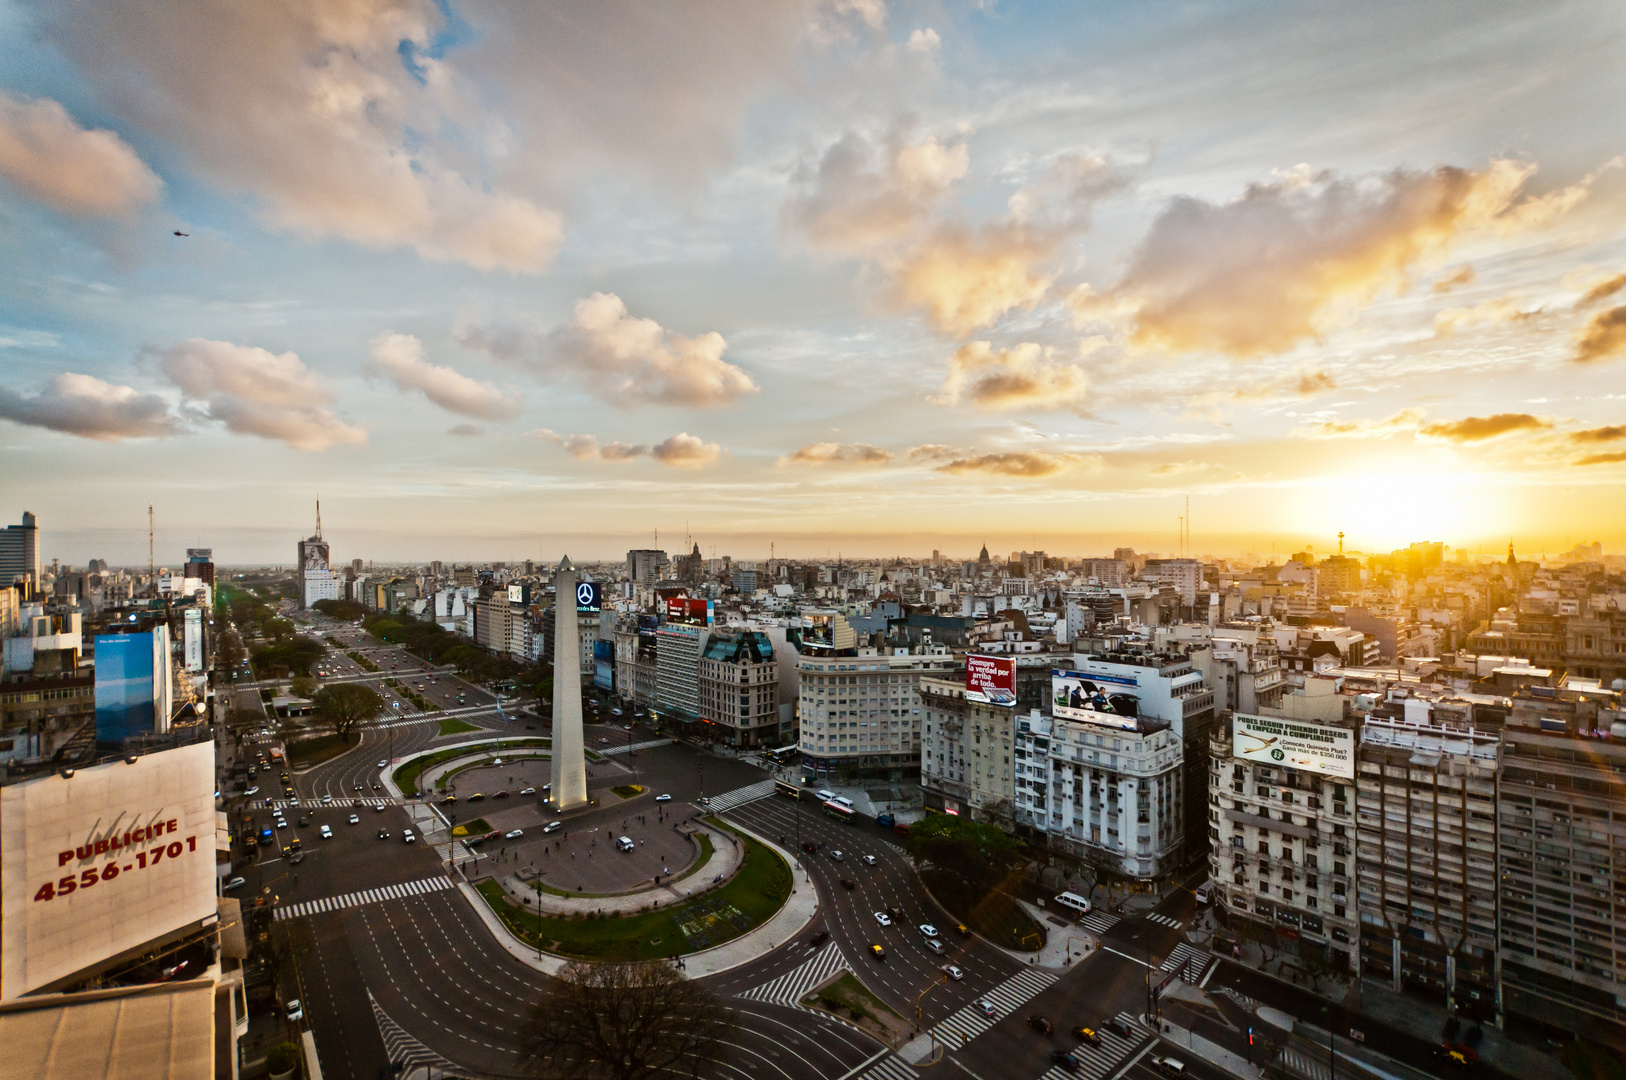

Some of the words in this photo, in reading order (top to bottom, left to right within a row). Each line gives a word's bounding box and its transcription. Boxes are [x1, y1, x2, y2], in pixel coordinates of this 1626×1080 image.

[969, 657, 994, 667] Siempre
[975, 666, 997, 674] verdad
[980, 679, 996, 688] todo.
[1237, 717, 1258, 725] PODES
[1259, 720, 1283, 729] SEGUIR
[1285, 724, 1318, 734] PIDIENDO
[1320, 729, 1348, 739] DESEOS
[1252, 724, 1282, 735] EMPEZAR
[1289, 731, 1335, 743] CUMPLIRLOS
[1306, 743, 1329, 751] Quiniela
[1320, 751, 1347, 760] $350.000
[58, 818, 177, 867] PUBLICITE
[34, 835, 197, 902] 4556-1701
